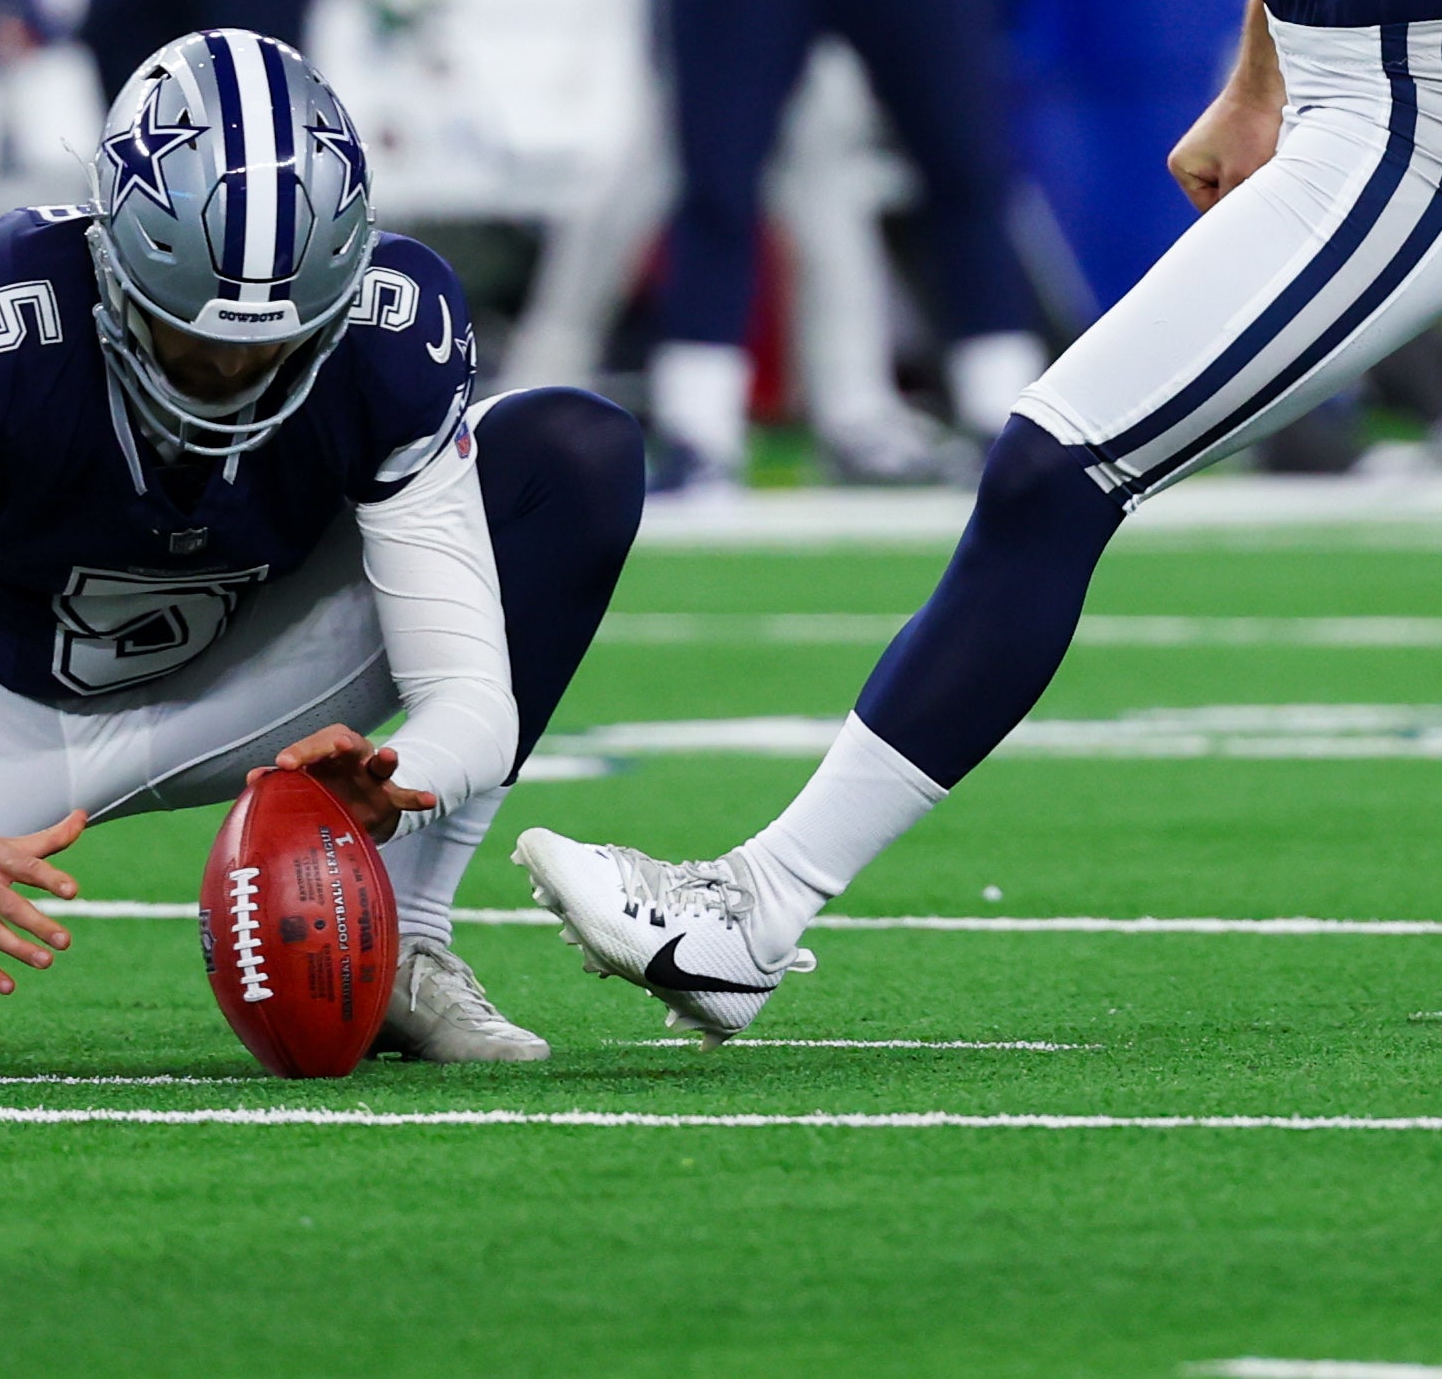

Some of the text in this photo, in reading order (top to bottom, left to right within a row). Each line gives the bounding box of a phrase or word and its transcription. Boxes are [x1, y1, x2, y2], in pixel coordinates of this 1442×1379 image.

[219, 310, 285, 323] COWBOYS
[319, 825, 340, 875] LEAGUE
[332, 879, 350, 951] FOOTBALL
